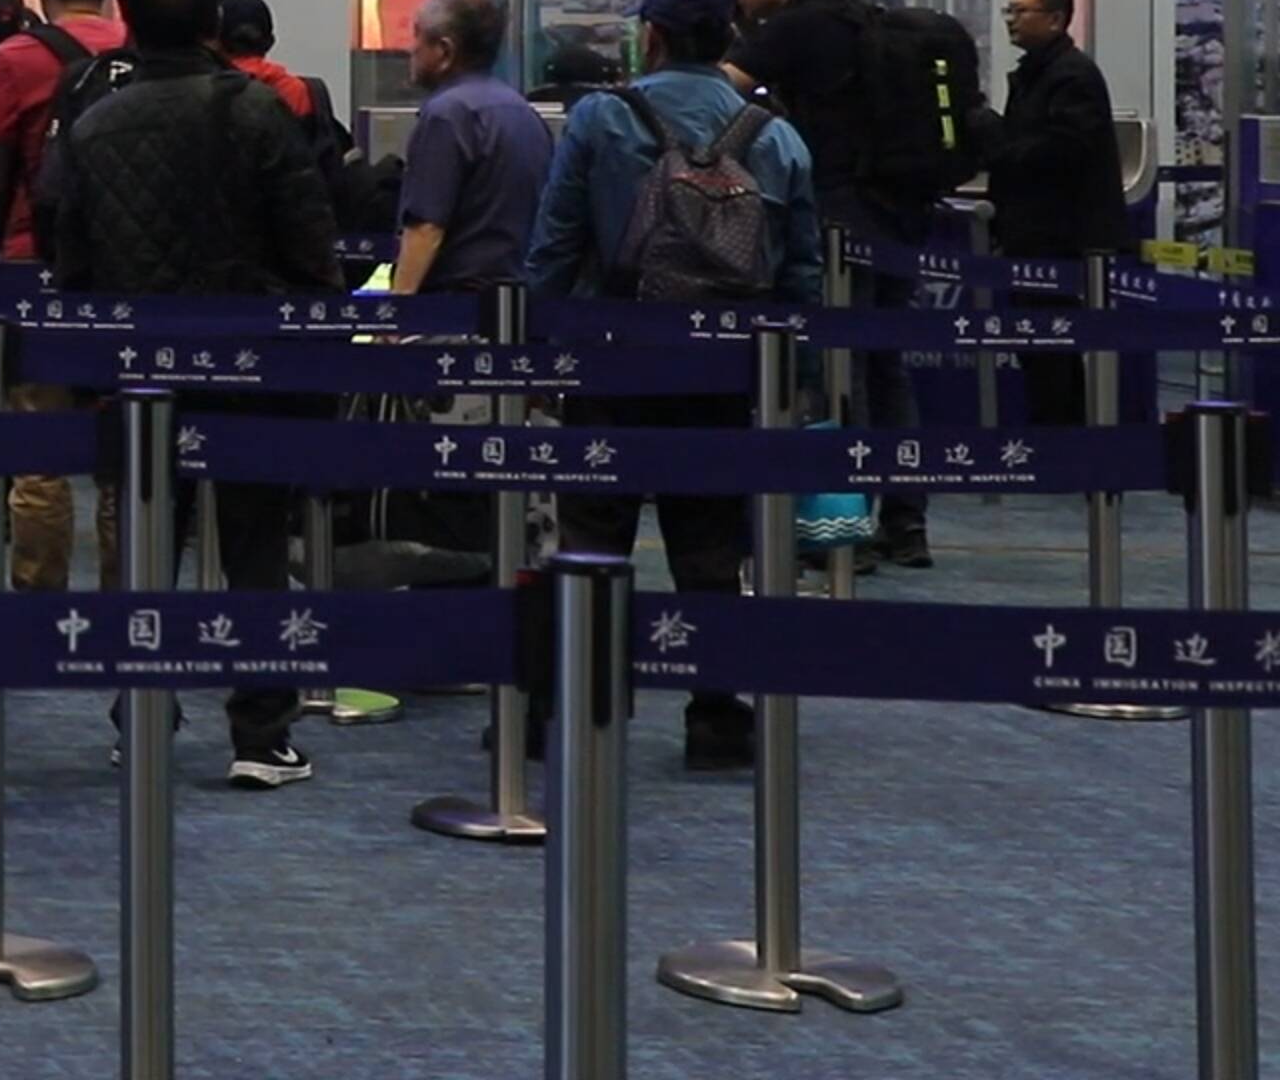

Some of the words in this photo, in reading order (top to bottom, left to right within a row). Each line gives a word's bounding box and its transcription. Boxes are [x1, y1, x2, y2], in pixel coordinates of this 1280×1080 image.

[433, 435, 617, 468] 中国边检
[847, 439, 1033, 470] 中国边检
[56, 608, 327, 653] 中国边检
[57, 662, 104, 672] CHINA
[116, 661, 223, 673] IMMIGRATION
[233, 660, 329, 673] INSPECTION
[1033, 676, 1081, 688] CHINA
[1093, 679, 1198, 691] IMMIGRATION
